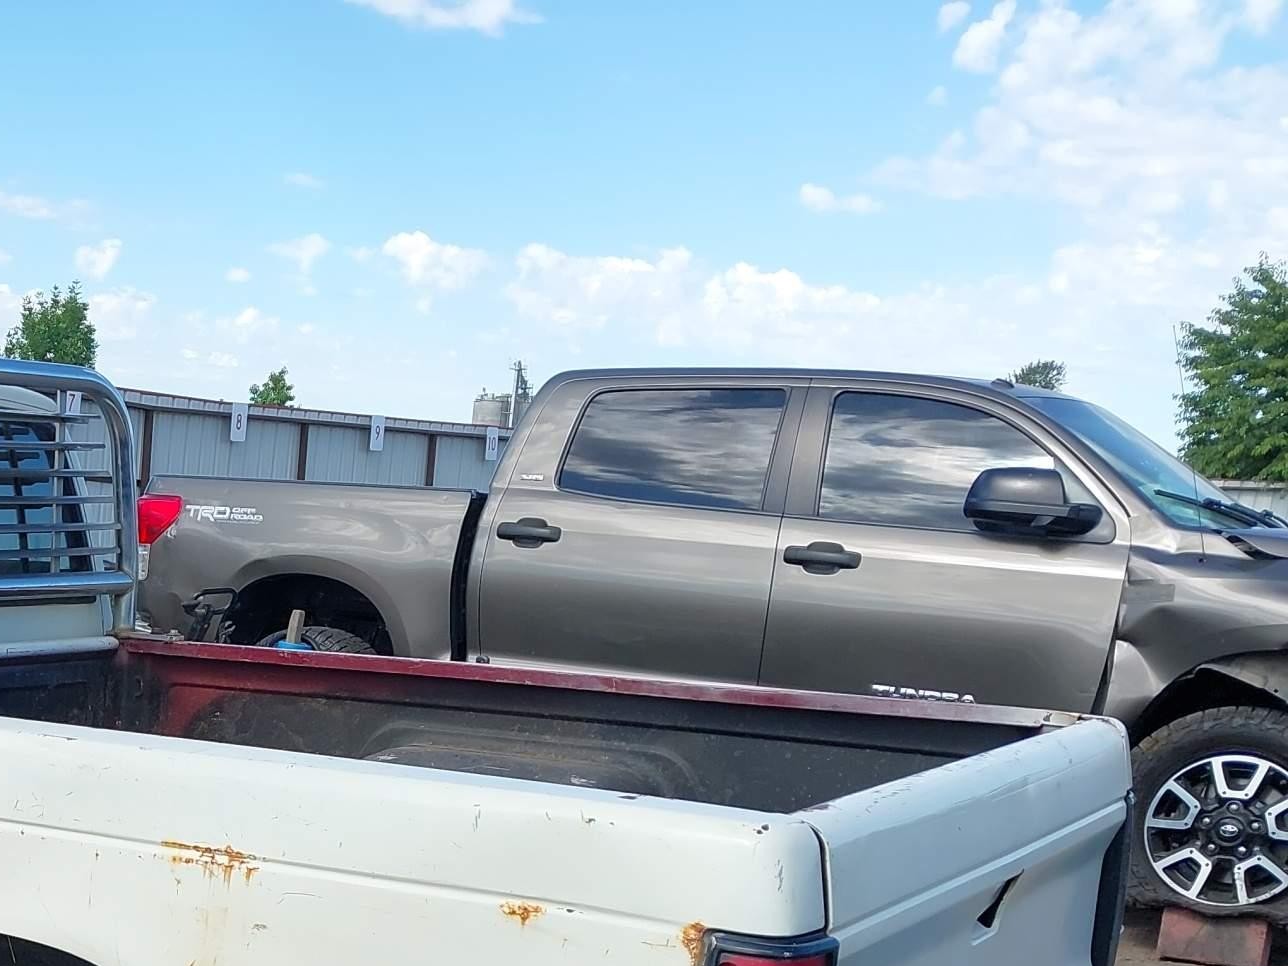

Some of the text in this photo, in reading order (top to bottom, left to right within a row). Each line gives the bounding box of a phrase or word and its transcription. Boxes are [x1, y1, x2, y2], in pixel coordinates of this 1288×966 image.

[68, 393, 76, 412] 7
[235, 413, 243, 431] 8
[375, 425, 381, 441] 9
[487, 436, 497, 452] 10
[185, 504, 231, 522] TRD
[230, 513, 265, 522] ROAD
